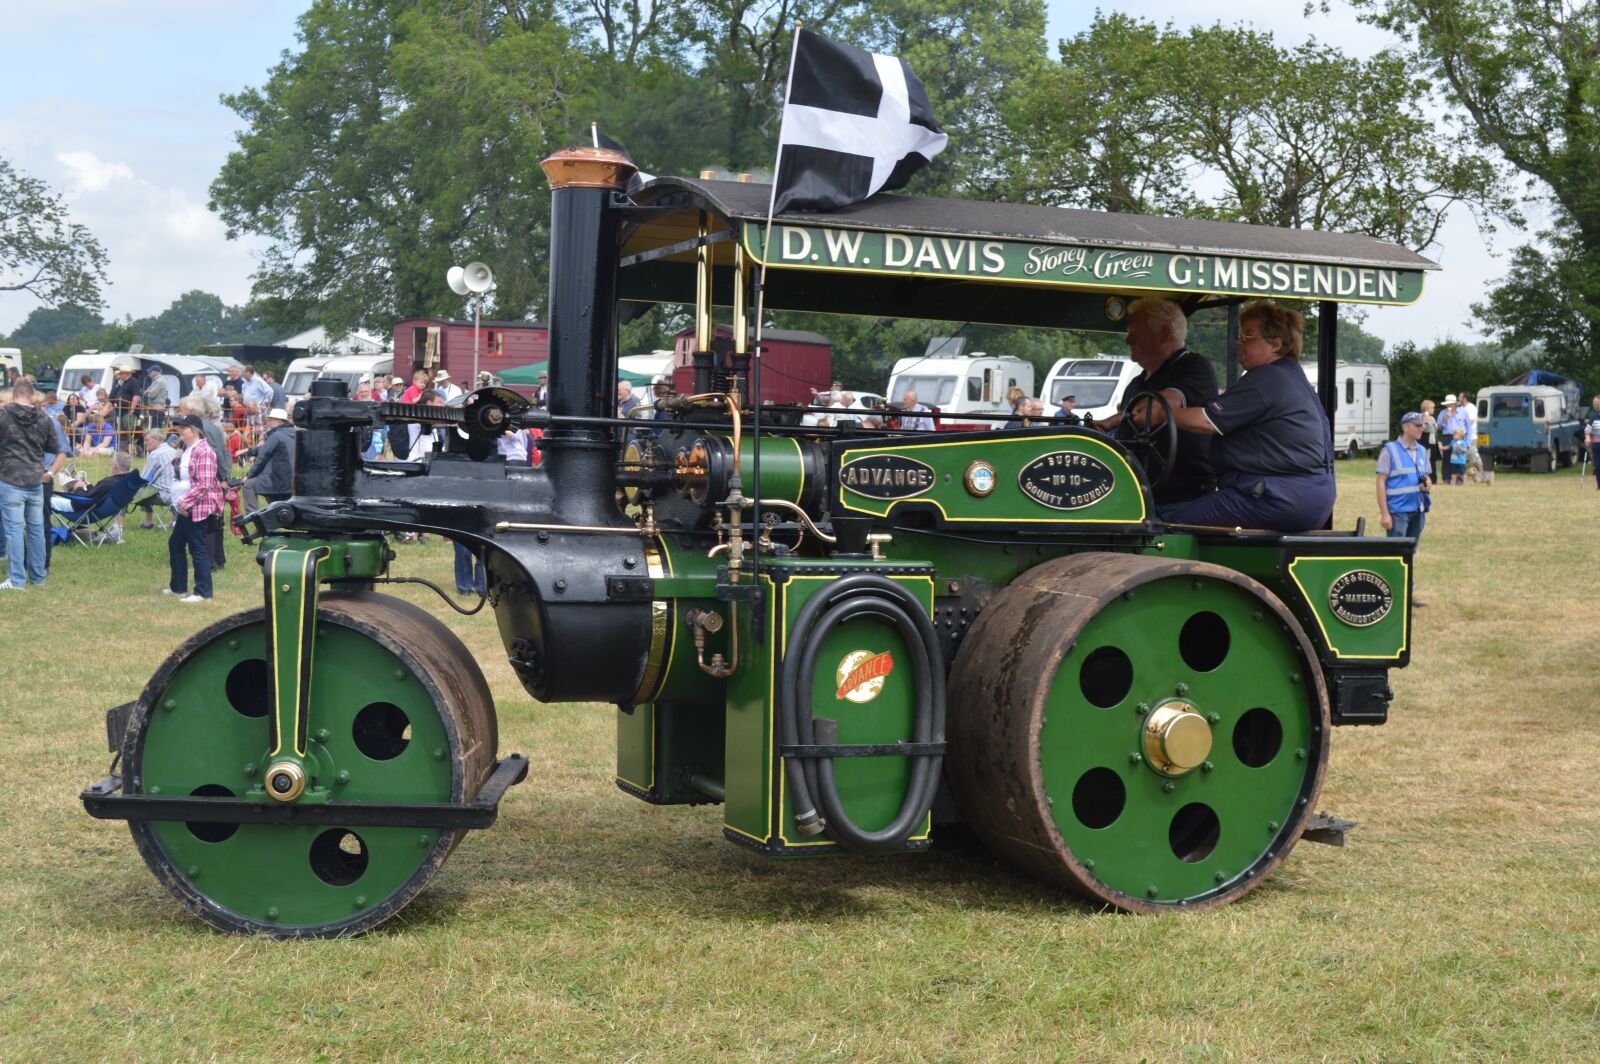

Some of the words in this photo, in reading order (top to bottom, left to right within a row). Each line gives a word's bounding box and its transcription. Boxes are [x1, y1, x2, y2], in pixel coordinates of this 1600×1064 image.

[781, 226, 871, 265] D.W.
[885, 232, 1006, 273] DAVIS
[1023, 245, 1089, 276] Stoney
[1093, 250, 1155, 280] Green
[1213, 257, 1398, 299] MISSENDEN
[1047, 454, 1088, 466] BUCKS
[846, 467, 929, 486] ADVANCE
[1069, 474, 1082, 486] 10
[1025, 481, 1063, 505] COUNTY
[1070, 484, 1110, 505] COUNCIL
[1331, 576, 1350, 607] WALLIS
[1345, 593, 1377, 603] MAKERS
[842, 653, 887, 694] ADVANCE
